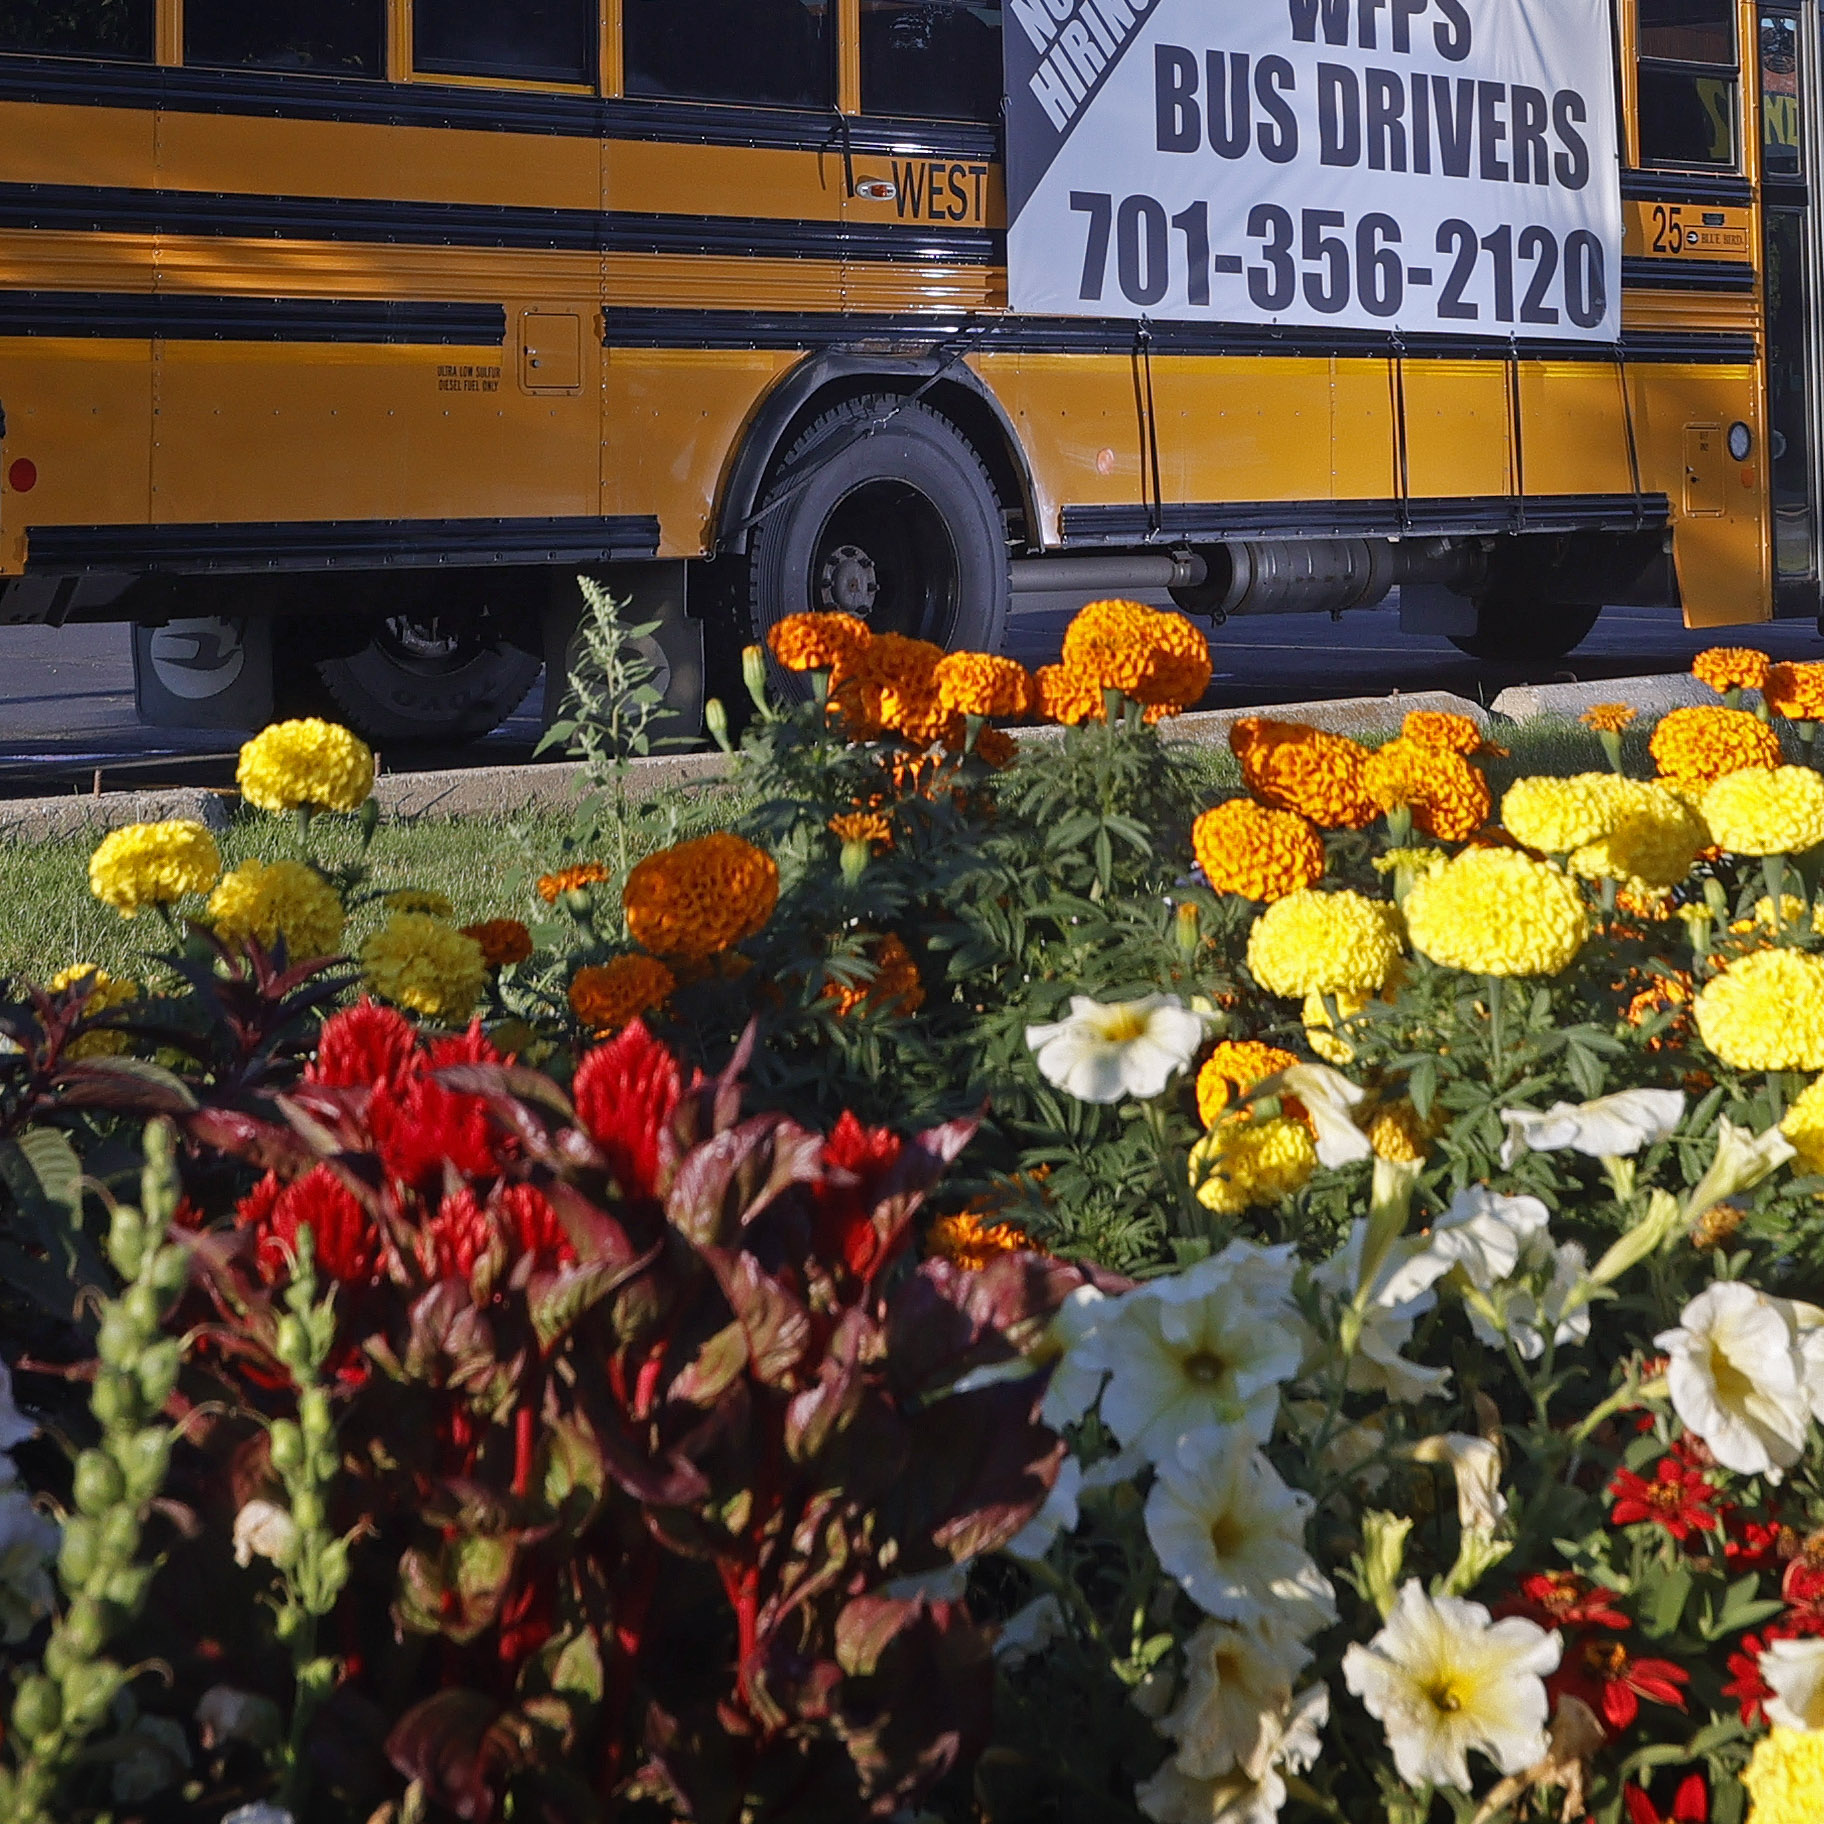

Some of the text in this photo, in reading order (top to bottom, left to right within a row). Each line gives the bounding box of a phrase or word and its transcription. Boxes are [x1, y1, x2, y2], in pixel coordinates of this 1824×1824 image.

[1154, 43, 1299, 164] BUS
[1316, 61, 1590, 191] DRIVERS
[891, 160, 988, 222] WEST
[1652, 205, 1683, 254] 25
[1068, 190, 1608, 329] 701-356-2120
